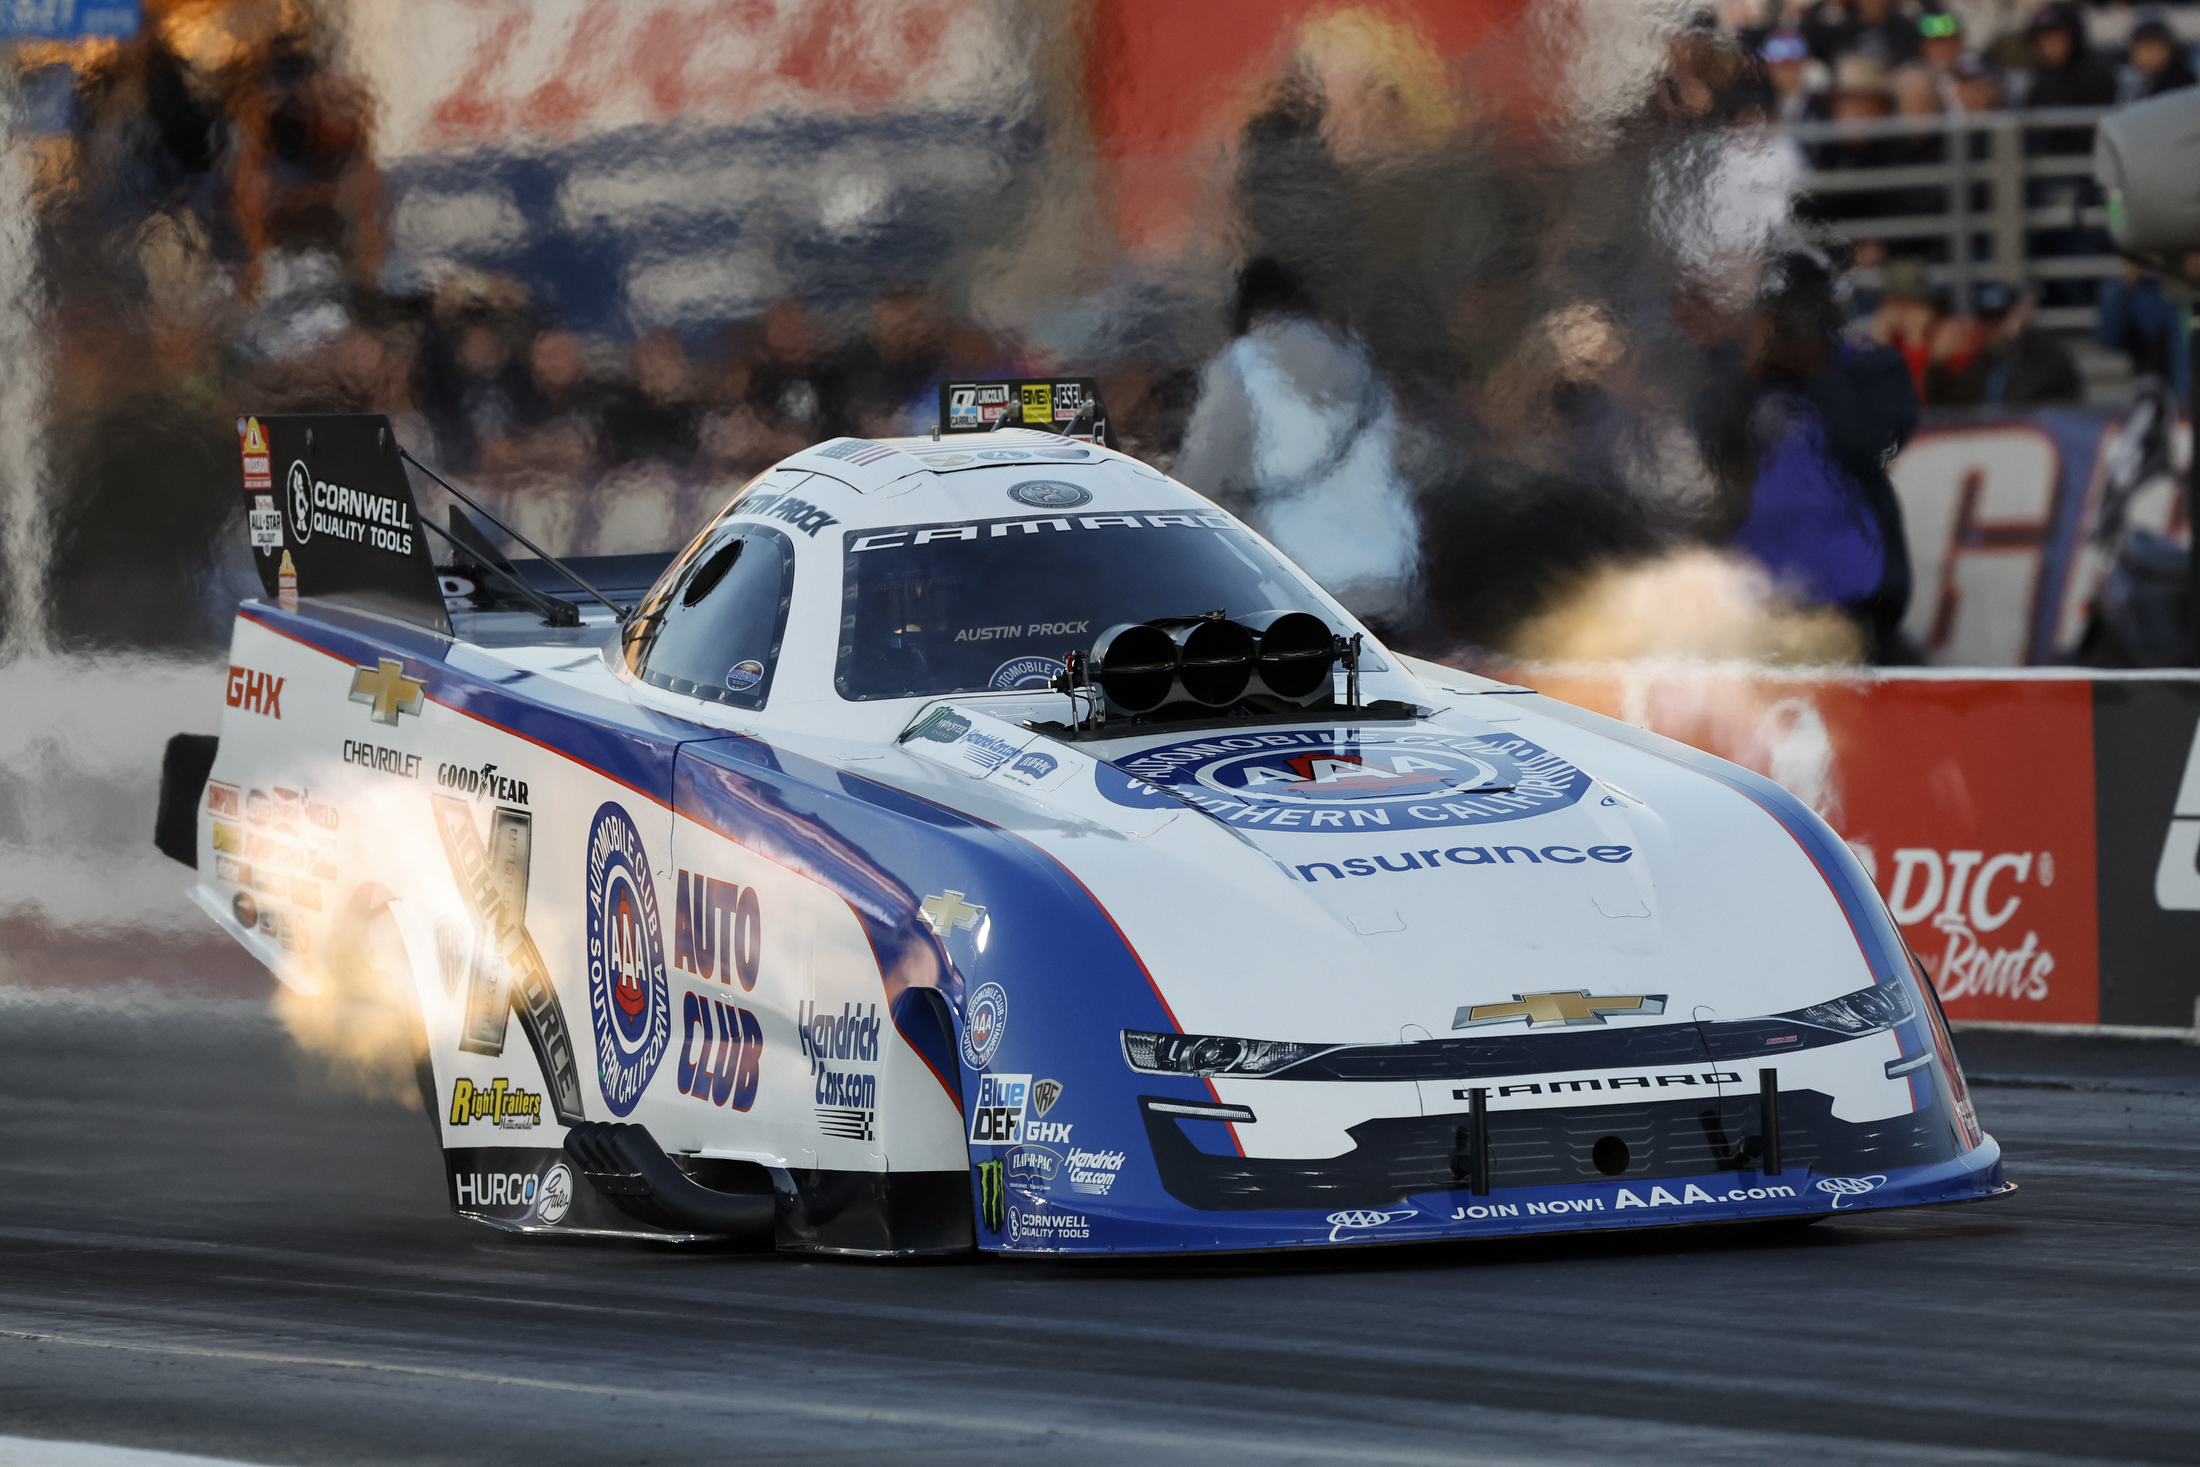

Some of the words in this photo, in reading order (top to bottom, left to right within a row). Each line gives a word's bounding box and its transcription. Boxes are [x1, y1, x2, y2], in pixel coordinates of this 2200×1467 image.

[243, 457, 269, 474] MISSION
[313, 480, 410, 530] CORNWELL
[765, 496, 841, 539] PROCK
[313, 511, 366, 543] QUALITY
[370, 526, 413, 555] TOOLS
[850, 514, 1240, 553] CAMARO
[954, 623, 1022, 643] AUSTIN
[1027, 620, 1090, 638] PROCK
[225, 665, 285, 720] GHX
[995, 660, 1052, 688] UTOMOBILE
[343, 739, 422, 780] CHEVROLET
[1242, 755, 1457, 787] AAA
[1407, 756, 1577, 821] CALIFORNIA
[308, 800, 339, 831] WELD
[590, 815, 635, 918] AUTOMOBILE
[635, 852, 657, 937] CLUB
[675, 869, 761, 992] AUTO
[611, 912, 646, 990] AAA
[506, 941, 575, 1099] FORCE
[967, 987, 999, 1020] AUTOMOBILE
[994, 994, 1005, 1017] CLUB
[590, 940, 620, 1102] SOUTHERN
[618, 962, 665, 1105] CALIFORNIA
[798, 1000, 880, 1075] Hendrick
[974, 1013, 992, 1035] AAA
[677, 991, 763, 1113] CLUB
[978, 1021, 1003, 1065] CALIFORNIA
[815, 1060, 876, 1109] Cars.com
[981, 1077, 1026, 1107] Blue
[1452, 1072, 1743, 1100] CAMARO
[972, 1107, 1022, 1142] DEF
[1026, 1121, 1074, 1144] GHX
[1064, 1147, 1127, 1173] Hendrick
[1070, 1168, 1116, 1185] Cars.com
[455, 1173, 539, 1205] HURCO
[1450, 1203, 1519, 1220] JOIN
[1526, 1198, 1605, 1216] NOW!
[1614, 1183, 1797, 1210] AAA.com
[1021, 1214, 1088, 1228] CORNWELL
[1021, 1227, 1054, 1238] QUALITY
[1058, 1229, 1090, 1239] TOOLS
